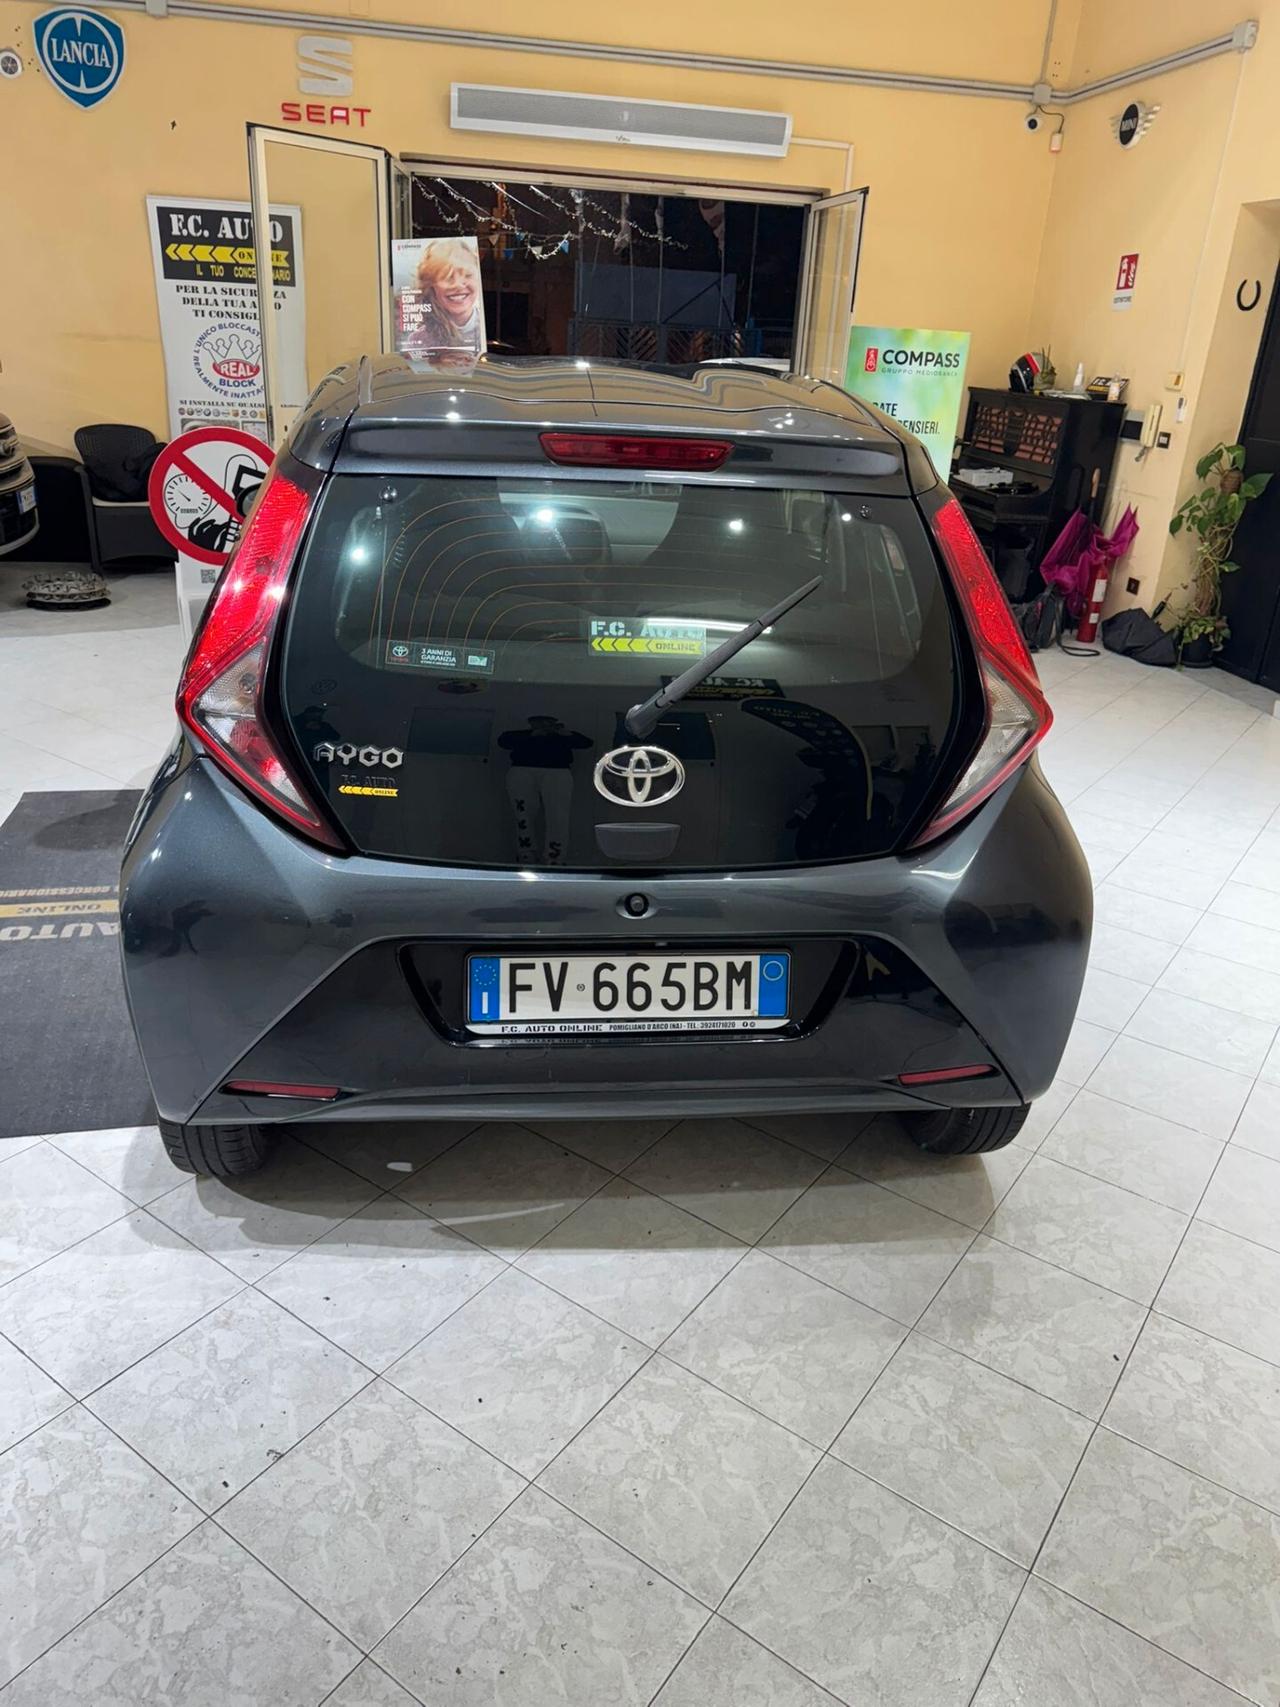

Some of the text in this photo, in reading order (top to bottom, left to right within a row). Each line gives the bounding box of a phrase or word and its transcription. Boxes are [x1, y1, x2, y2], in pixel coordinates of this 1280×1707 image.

[51, 37, 112, 68] LANCIA
[281, 103, 372, 127] SEAT
[169, 213, 209, 238] F.C.
[196, 264, 203, 276] IL
[210, 264, 224, 277] TUO
[176, 285, 287, 300] PER LA SICURZA
[182, 296, 282, 311] DELLA TUA AO
[192, 310, 260, 321] TI CONSIGL
[882, 349, 960, 368] COMPASS
[220, 361, 254, 378] REAL
[881, 367, 914, 375] GRUPPO
[219, 378, 256, 388] BLOCK
[873, 402, 898, 417] ATE
[898, 419, 941, 435] ENSIERI.
[591, 621, 632, 637] F.C.
[426, 648, 443, 656] ANNI
[656, 643, 696, 651] ONLINE
[420, 655, 456, 663] GARANZIA
[313, 742, 404, 769] AYGO
[508, 960, 752, 1013] FV 665BM
[525, 1025, 555, 1033] AUTO
[559, 1024, 602, 1032] ONLINE
[609, 1023, 646, 1031] POMIGLIANO
